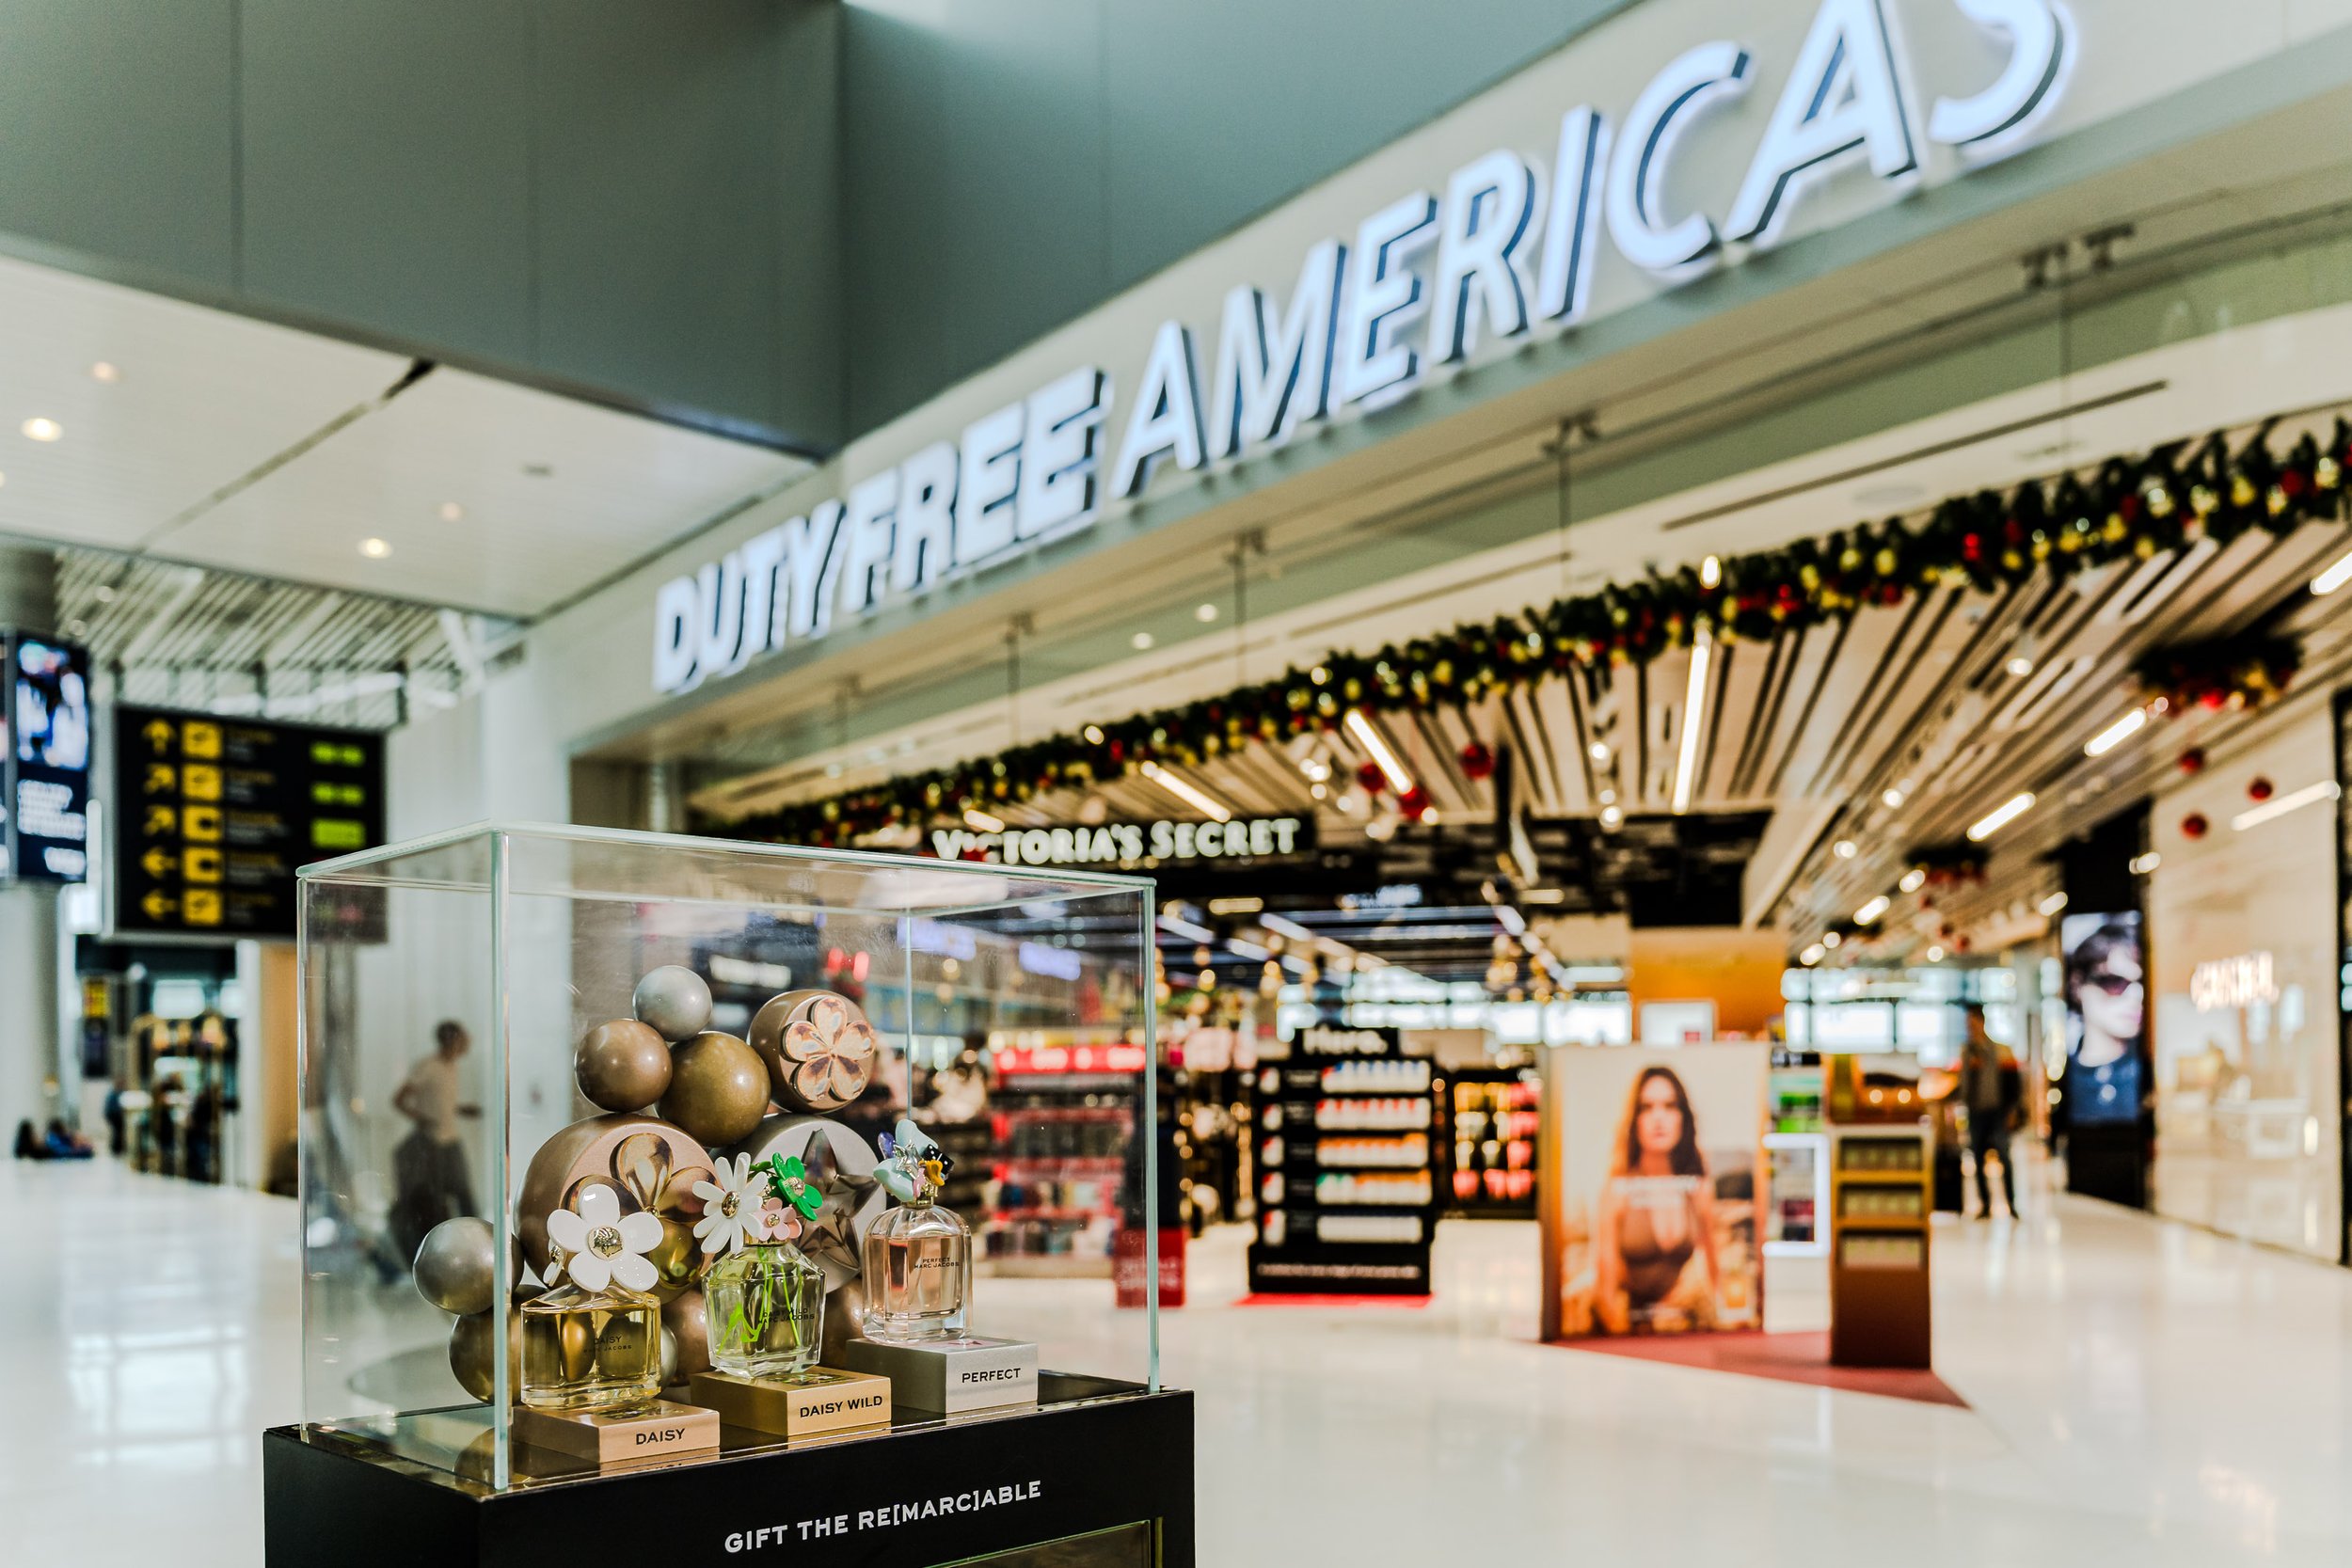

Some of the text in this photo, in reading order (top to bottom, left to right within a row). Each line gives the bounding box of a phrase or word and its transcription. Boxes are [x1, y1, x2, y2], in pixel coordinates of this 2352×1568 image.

[652, 0, 2063, 694] DUTY FREE AMERICAS
[1150, 818, 1301, 860] SECRET
[594, 1335, 623, 1345] DAISY
[961, 1368, 1022, 1383] PERFECT
[800, 1396, 883, 1418] DAISY WILD
[635, 1428, 686, 1445] DAISY
[724, 1480, 1041, 1553] GIFT THE RE[MARC]ABLE
